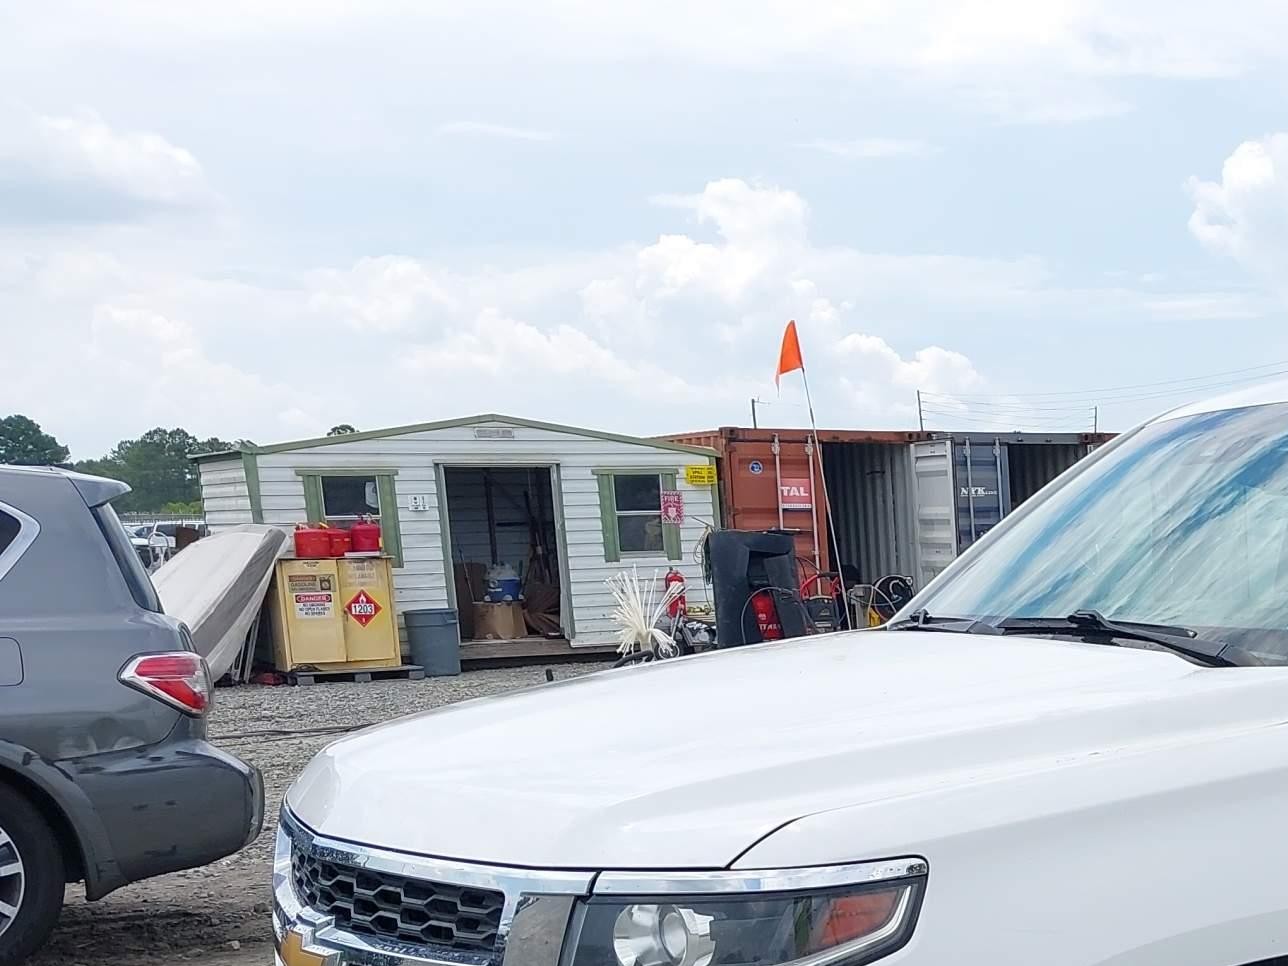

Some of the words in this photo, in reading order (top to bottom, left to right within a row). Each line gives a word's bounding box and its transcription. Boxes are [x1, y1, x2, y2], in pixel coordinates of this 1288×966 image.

[780, 486, 809, 497] TAL
[960, 486, 986, 497] NYK
[353, 604, 373, 613] 1203
